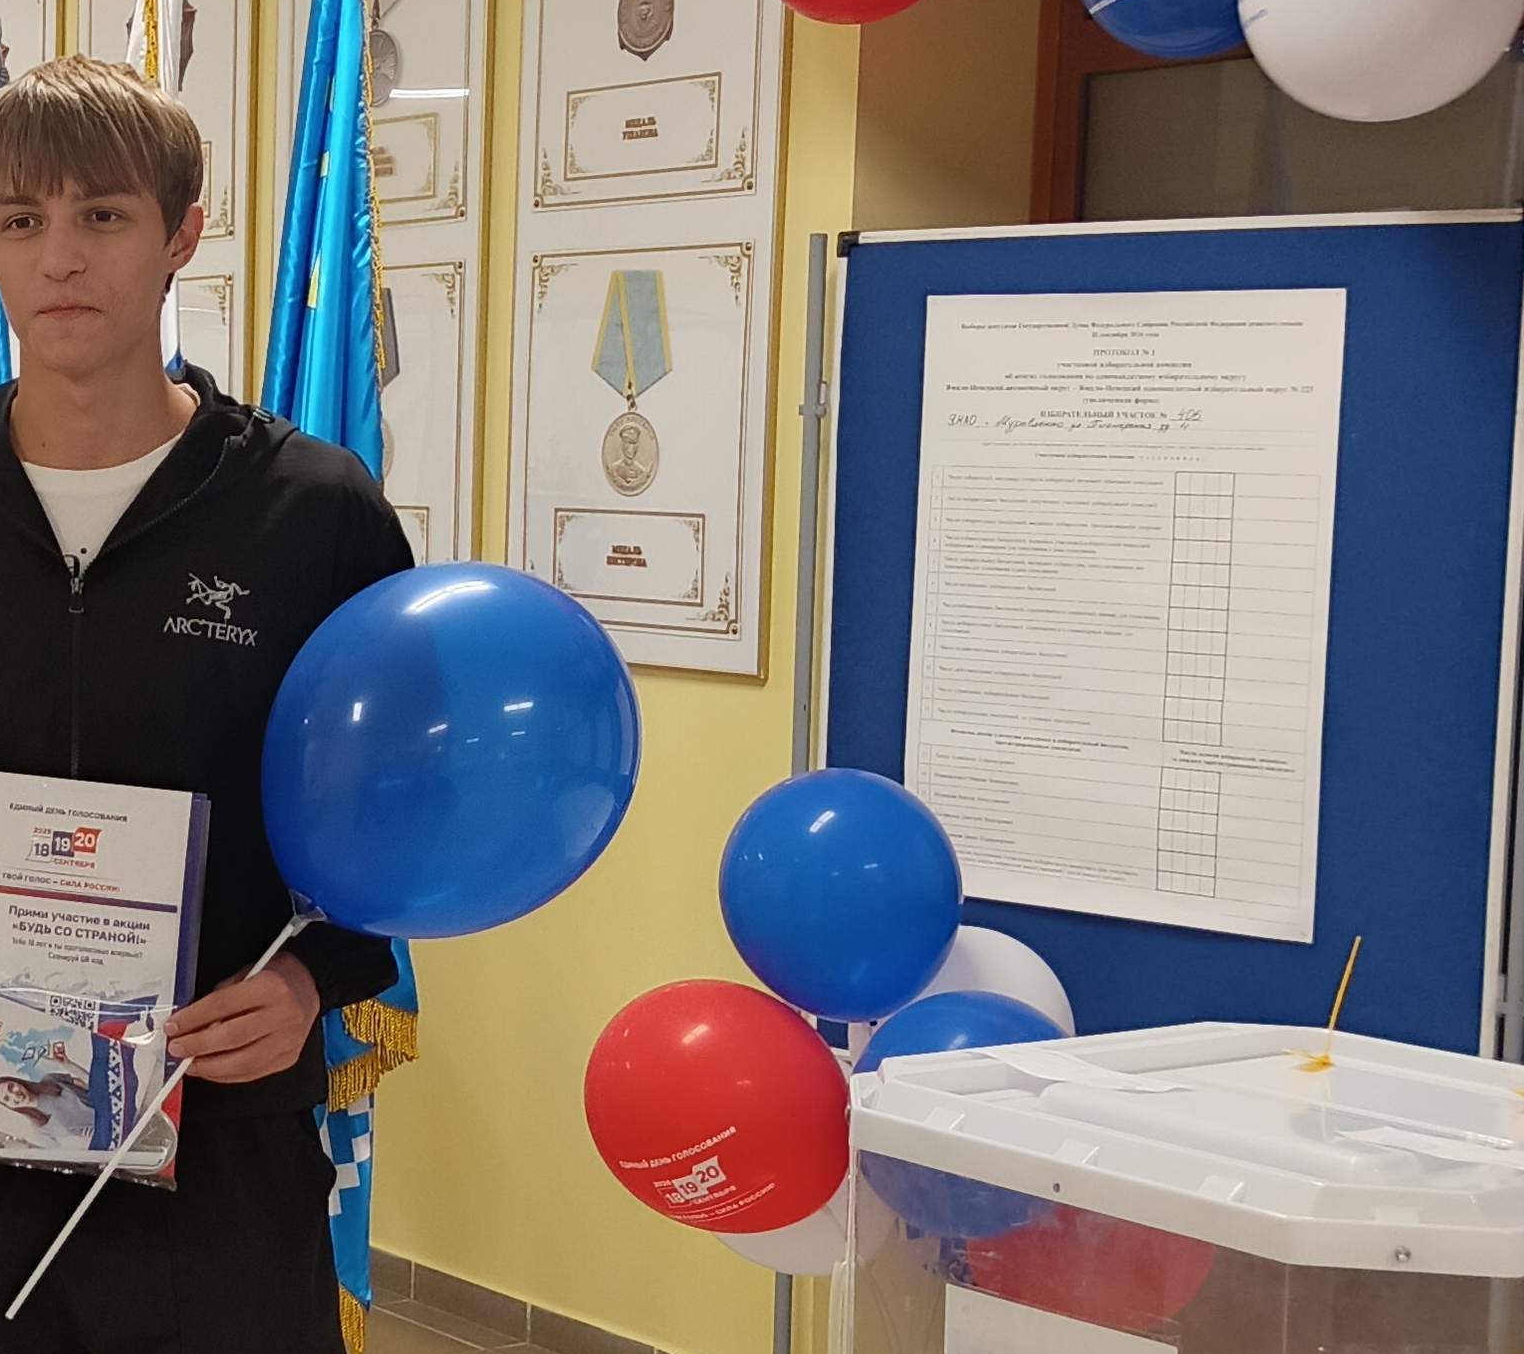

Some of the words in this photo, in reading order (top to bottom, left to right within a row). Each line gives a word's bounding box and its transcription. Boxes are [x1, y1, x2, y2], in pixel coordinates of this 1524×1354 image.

[34, 843, 50, 857] 18
[54, 836, 71, 852] 19
[74, 832, 96, 848] 20
[9, 905, 49, 919] Прими
[51, 911, 101, 926] участие
[113, 920, 151, 931] акции
[12, 921, 52, 935] «БУДЬ
[54, 925, 73, 937] СО
[75, 927, 147, 945] СТРАНОЙ!»
[672, 1126, 736, 1161] ГОЛОСОВАНИЯ
[679, 1181, 699, 1195] 19
[696, 1165, 719, 1184] 20
